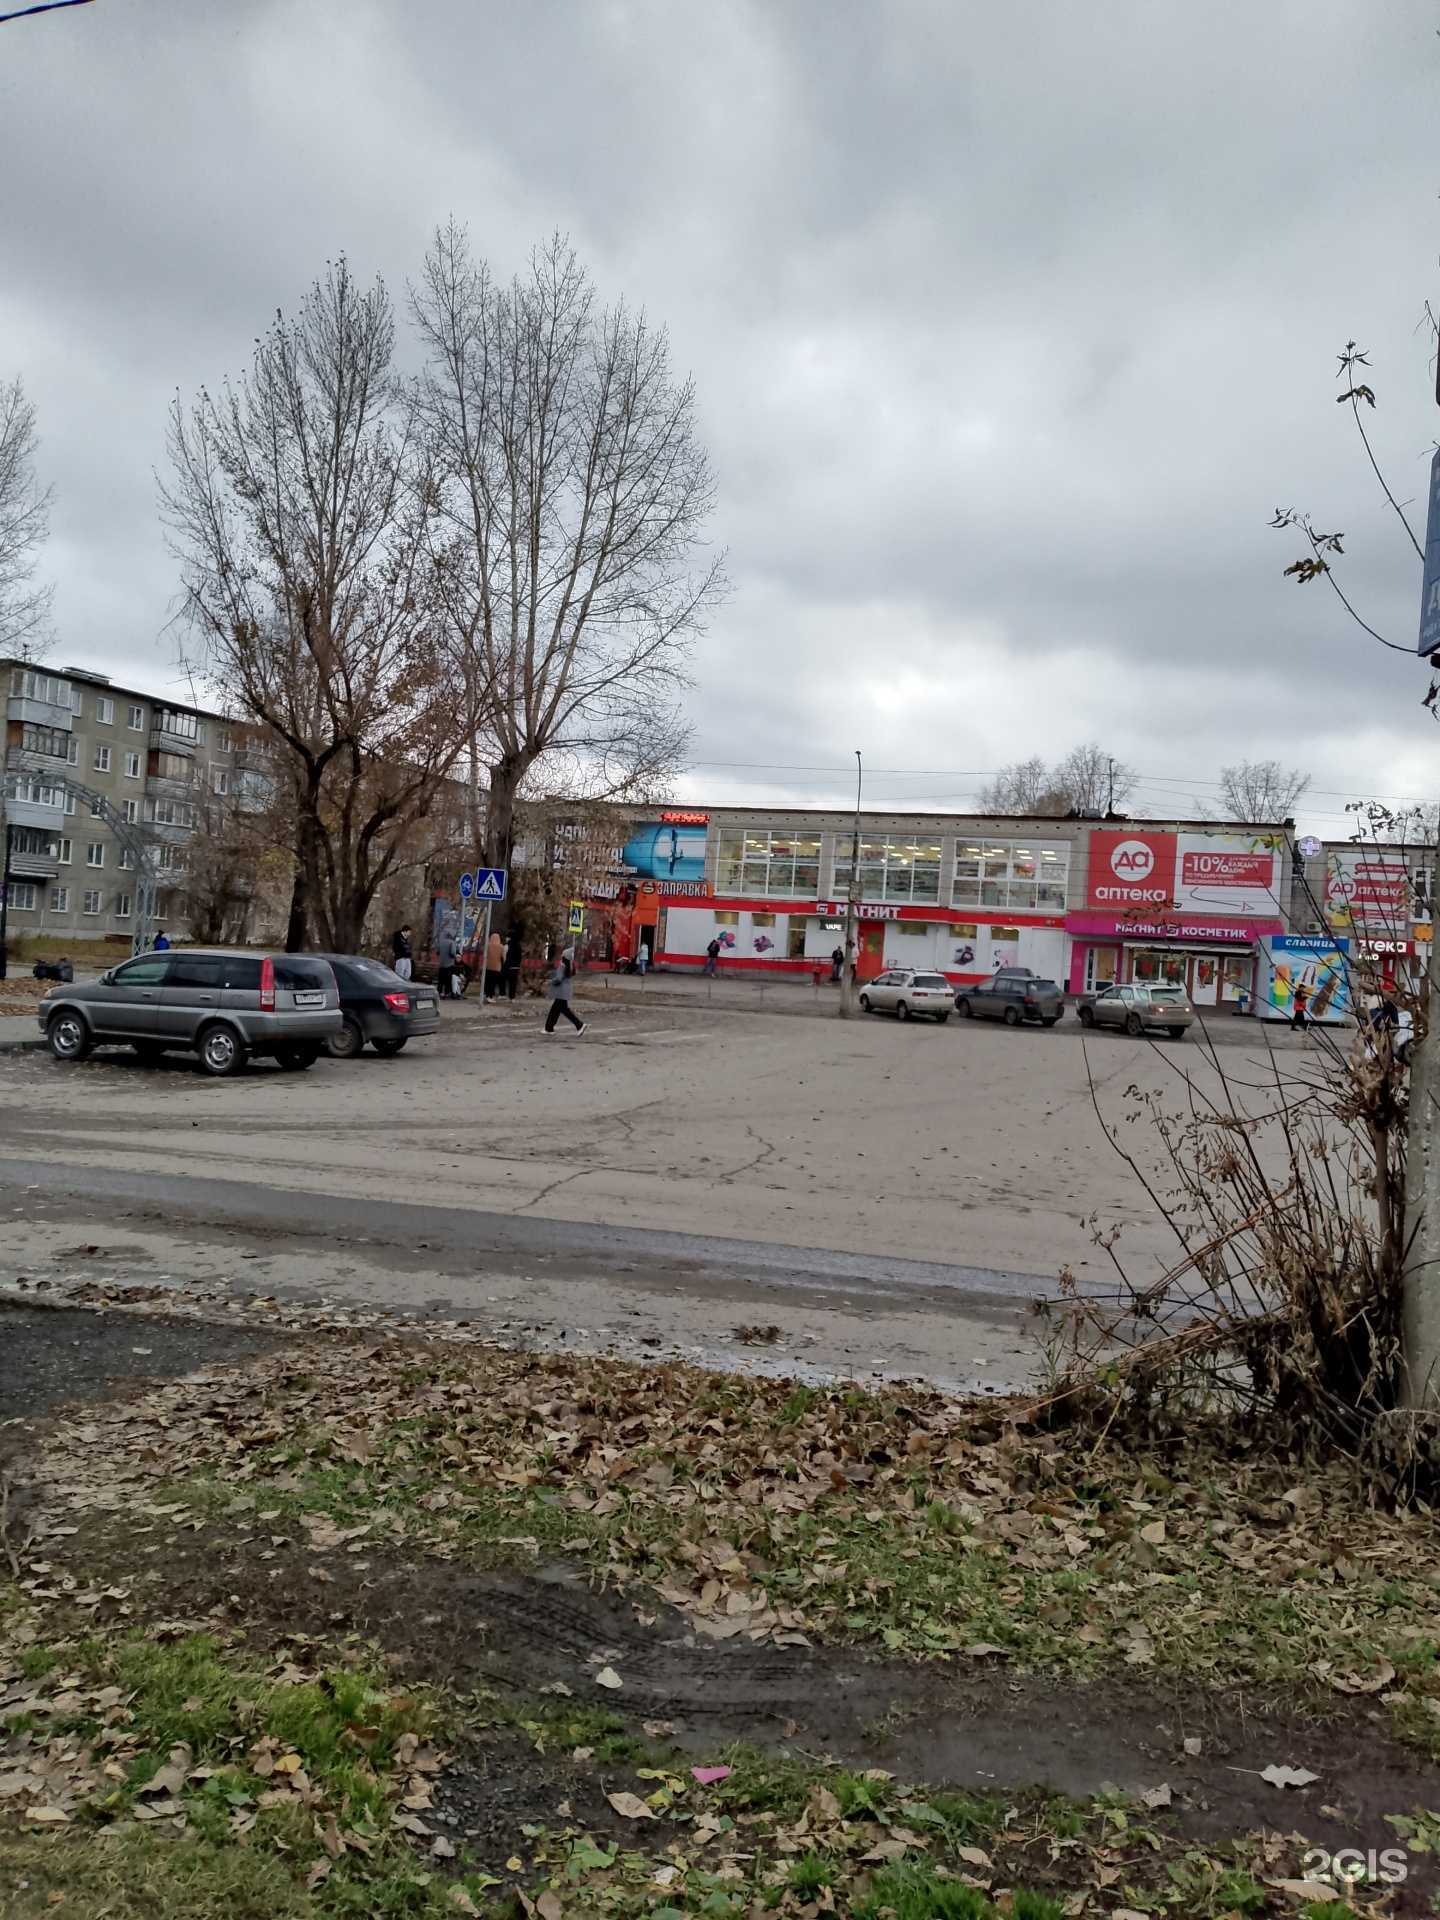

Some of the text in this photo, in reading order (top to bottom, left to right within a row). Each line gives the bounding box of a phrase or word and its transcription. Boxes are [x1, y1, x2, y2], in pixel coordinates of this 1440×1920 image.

[1186, 856, 1229, 873] -10%
[656, 882, 708, 897] ЗАПРАВКА
[1115, 923, 1248, 939] МАГНИТ КОСМЕТИК
